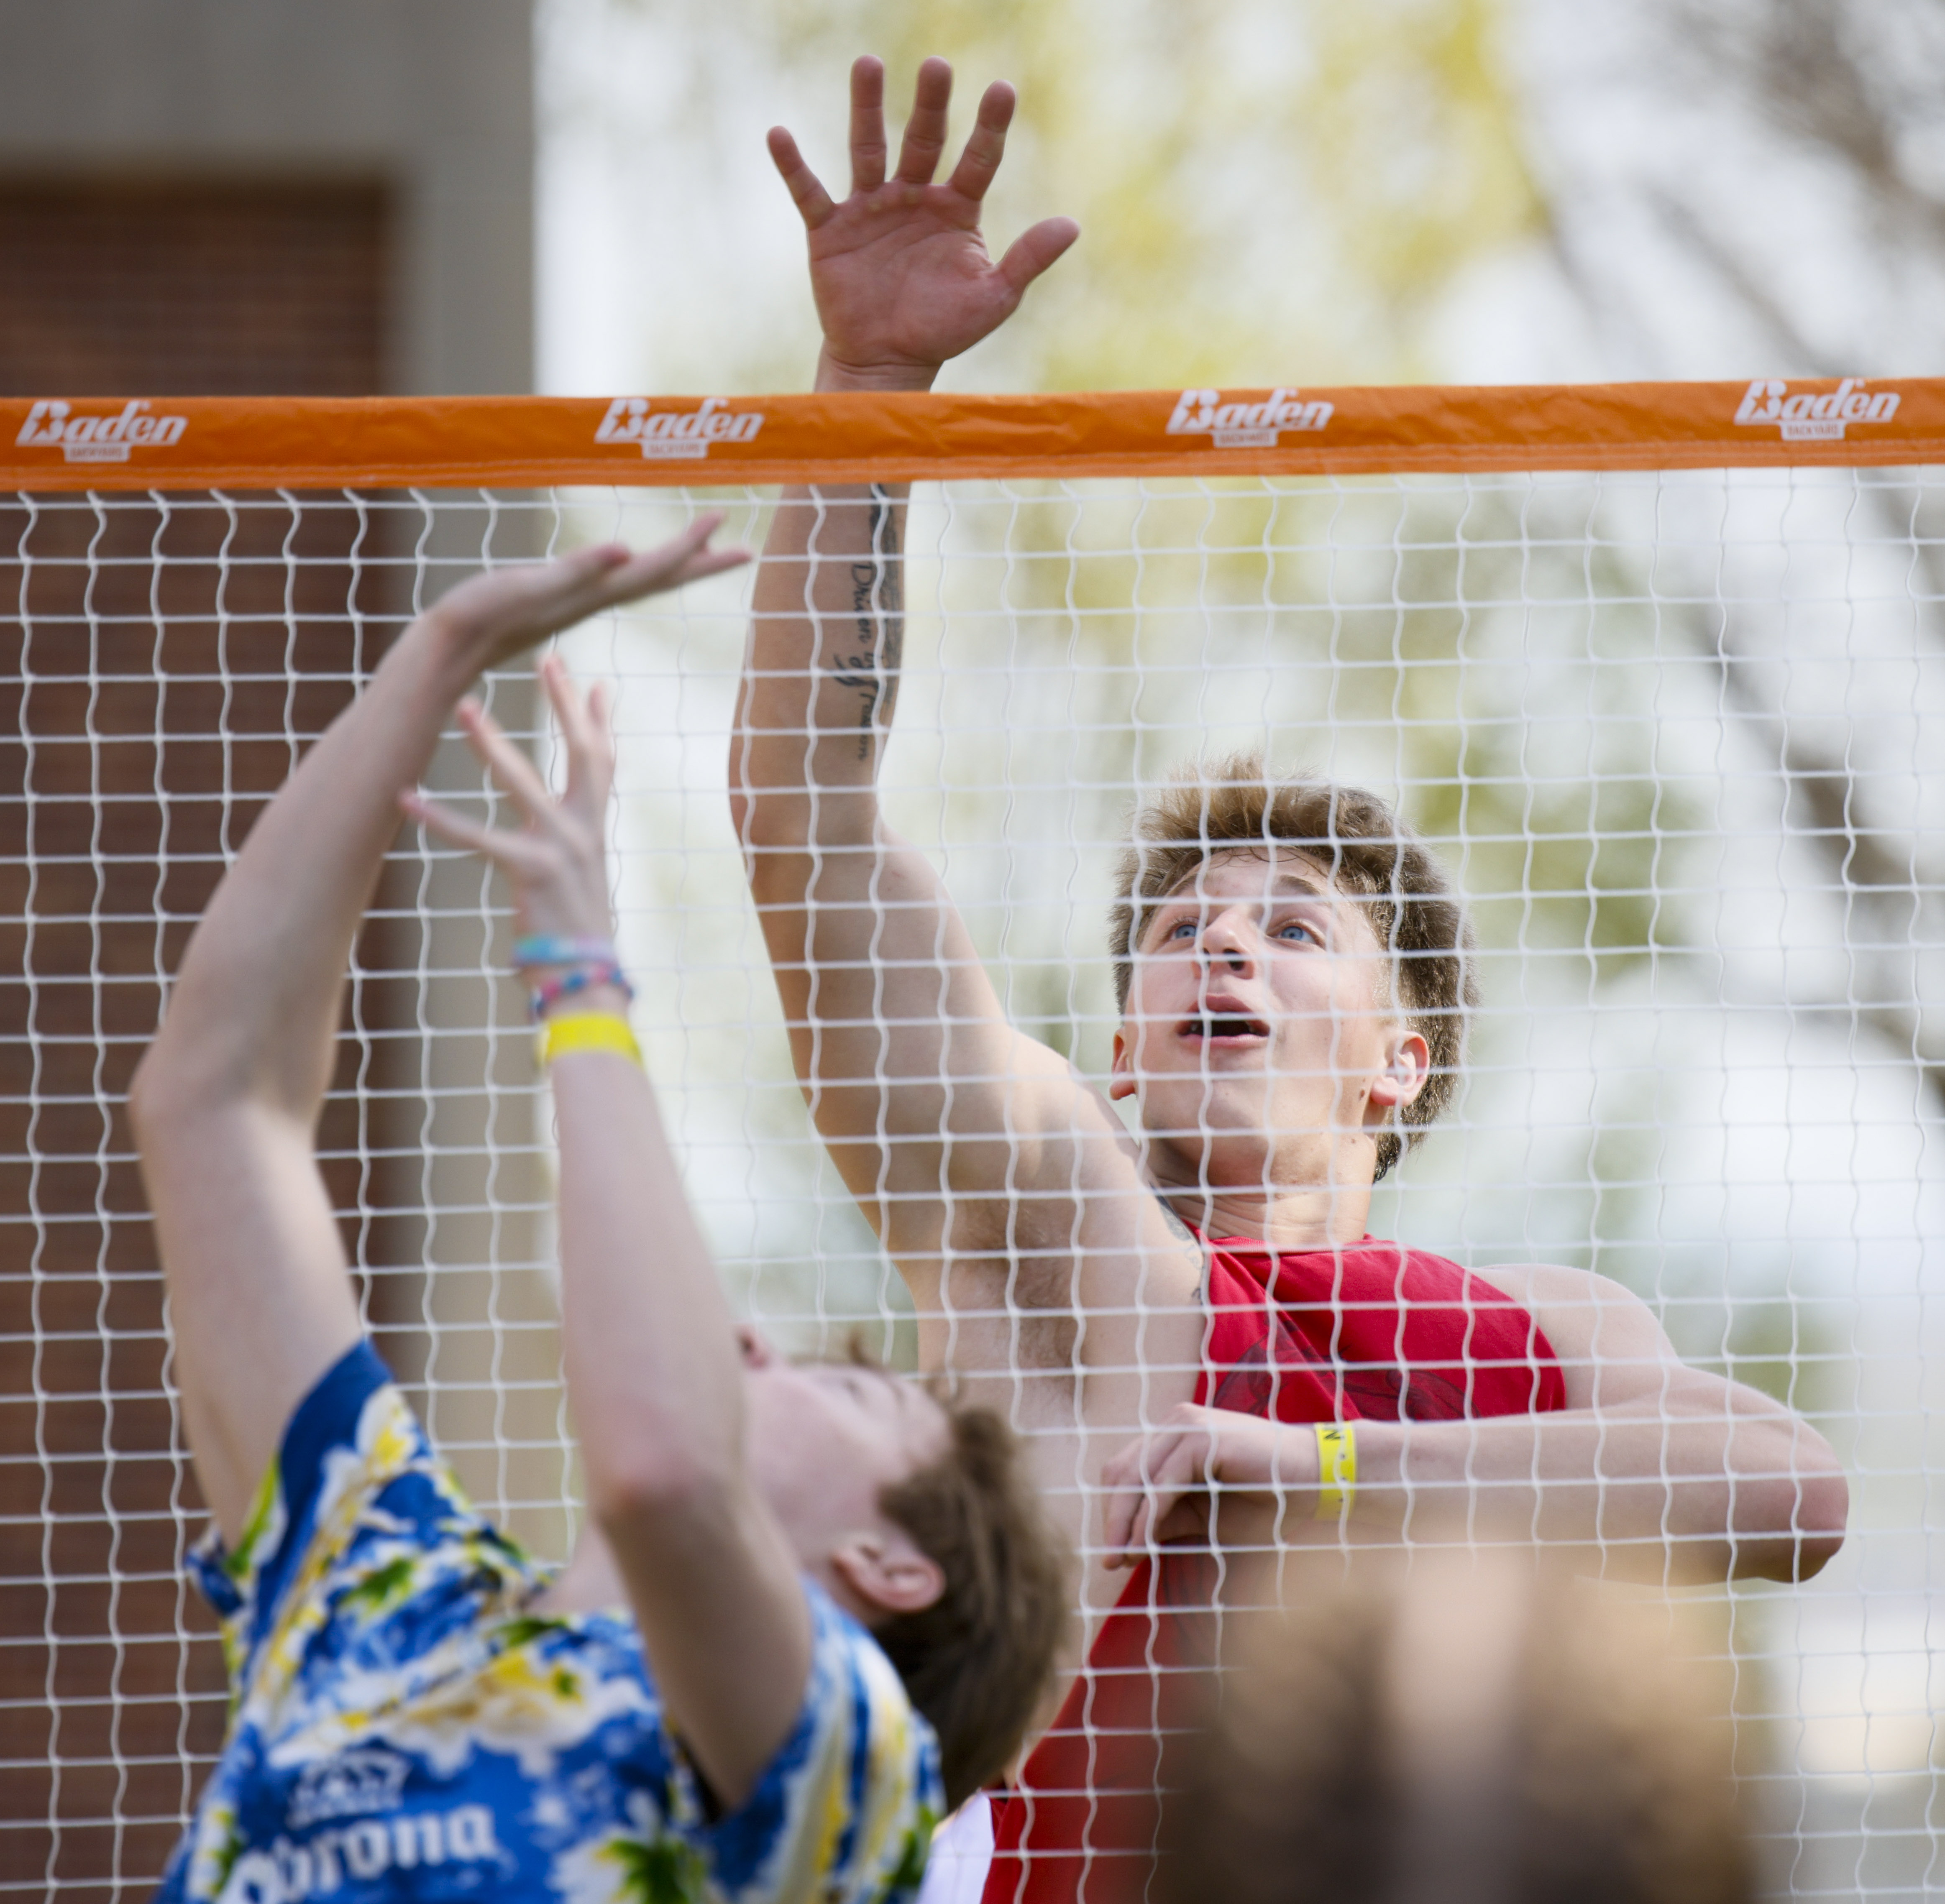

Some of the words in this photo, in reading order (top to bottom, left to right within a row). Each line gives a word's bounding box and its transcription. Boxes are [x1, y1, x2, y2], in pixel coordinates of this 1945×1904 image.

[15, 400, 189, 447] Baden
[594, 397, 765, 443] Baden
[1166, 387, 1335, 434] Baden
[1734, 378, 1901, 425] Baden
